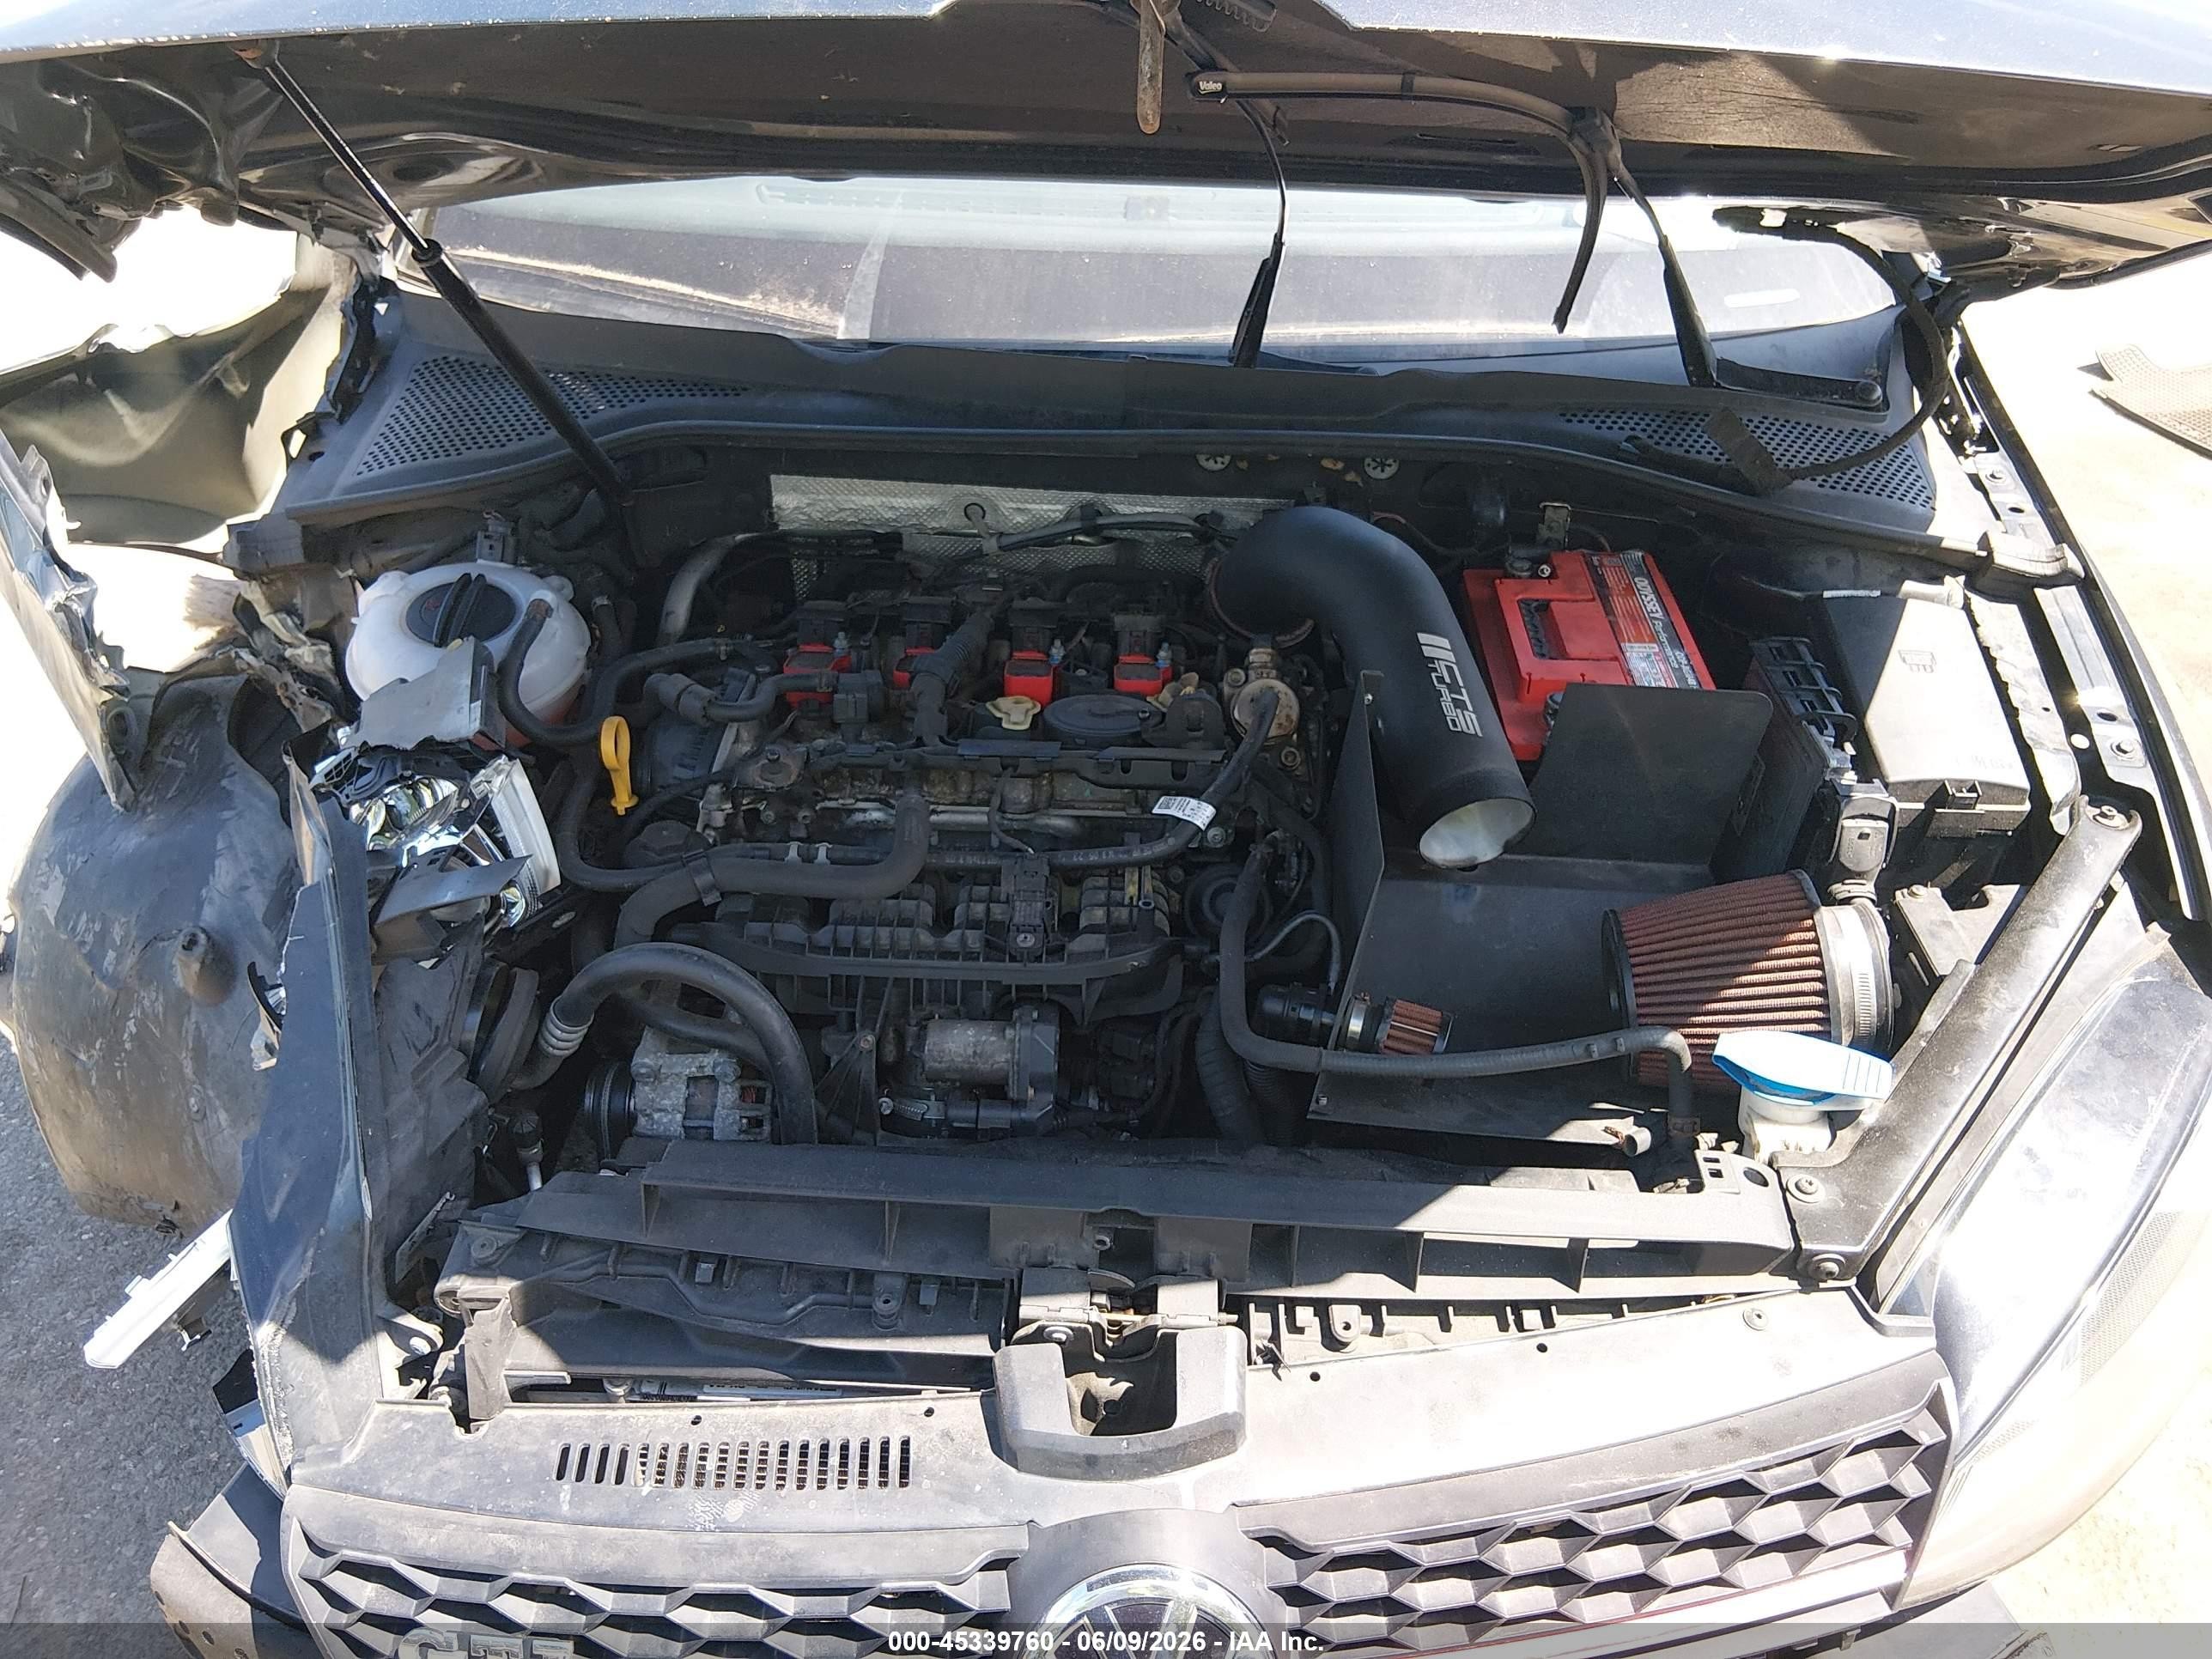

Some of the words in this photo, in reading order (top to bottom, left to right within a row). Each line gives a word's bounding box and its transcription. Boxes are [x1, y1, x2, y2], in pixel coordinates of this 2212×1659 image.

[1199, 81, 1223, 91] Valeo
[1634, 577, 1664, 622] ODYSSEY
[1427, 659, 1462, 732] TURBO
[1437, 659, 1483, 737] CTS
